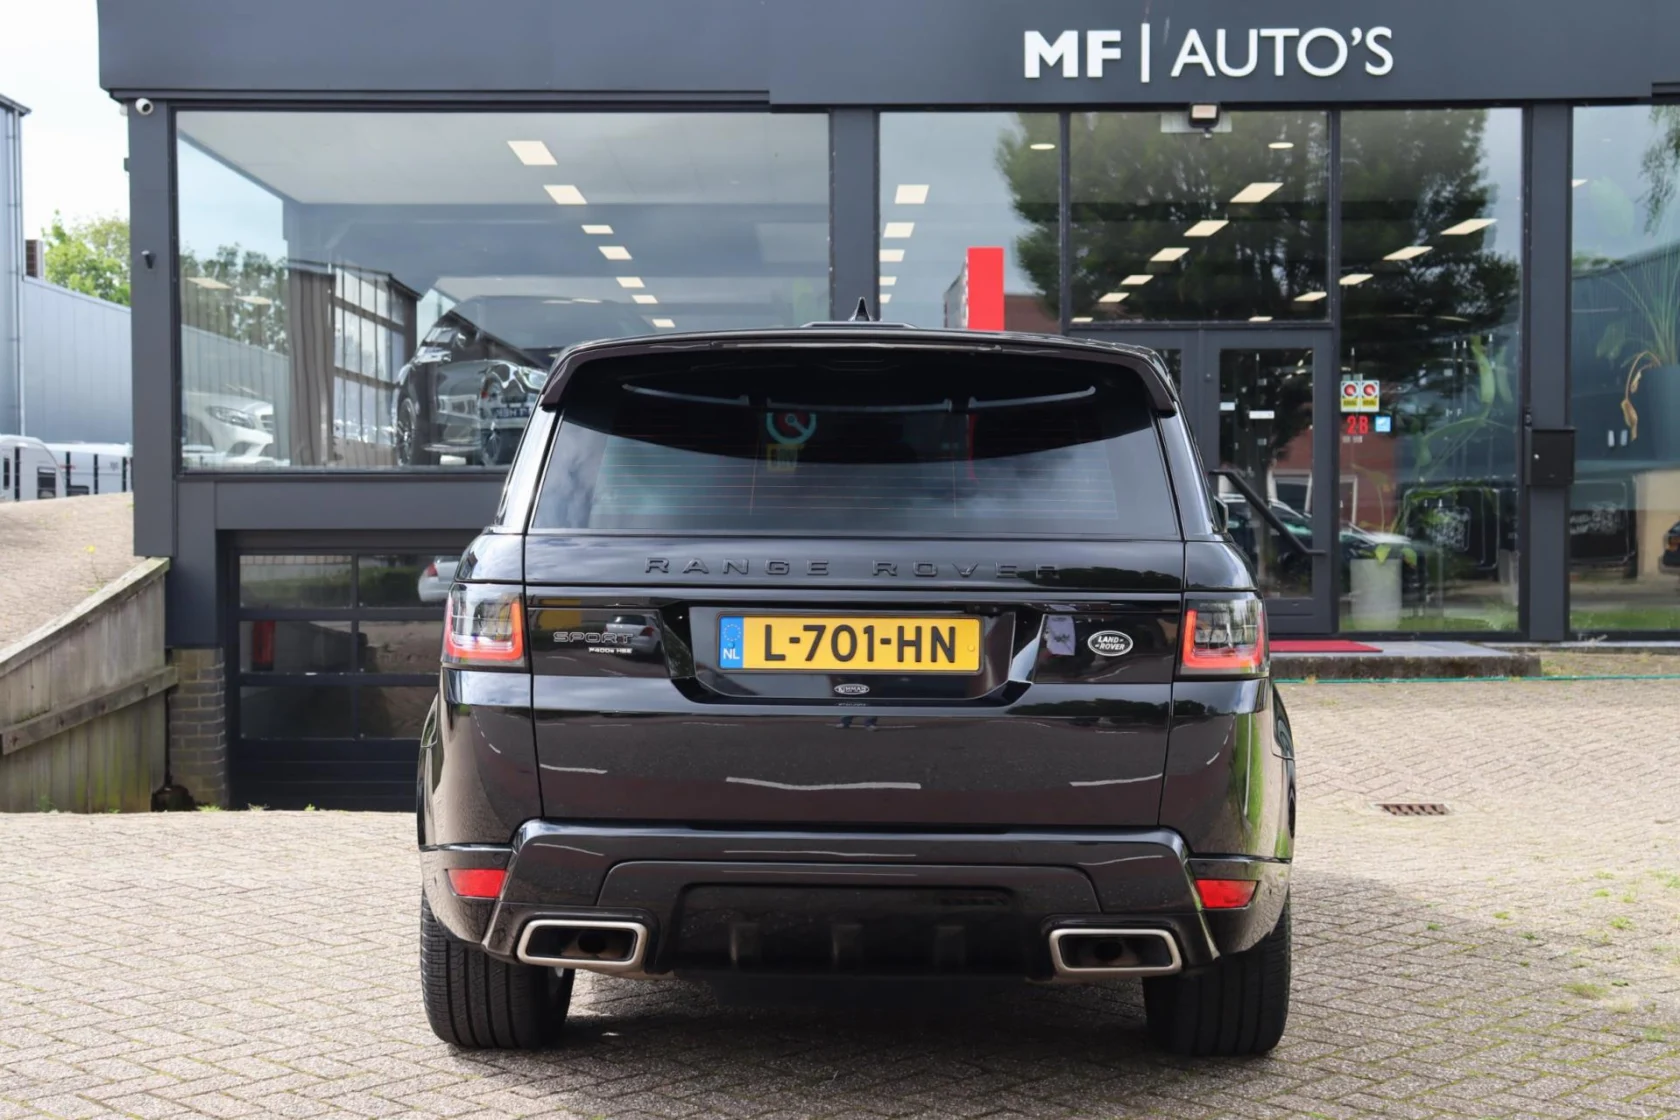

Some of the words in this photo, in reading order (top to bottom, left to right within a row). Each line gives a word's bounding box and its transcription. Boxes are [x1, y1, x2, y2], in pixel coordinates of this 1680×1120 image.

[1024, 30, 1122, 78] MF
[1170, 26, 1394, 78] AUTO'S
[644, 557, 830, 576] RANGE
[872, 560, 1061, 580] ROVER
[553, 631, 634, 644] SPORT
[763, 623, 956, 664] L-701-HN
[723, 648, 740, 660] NL
